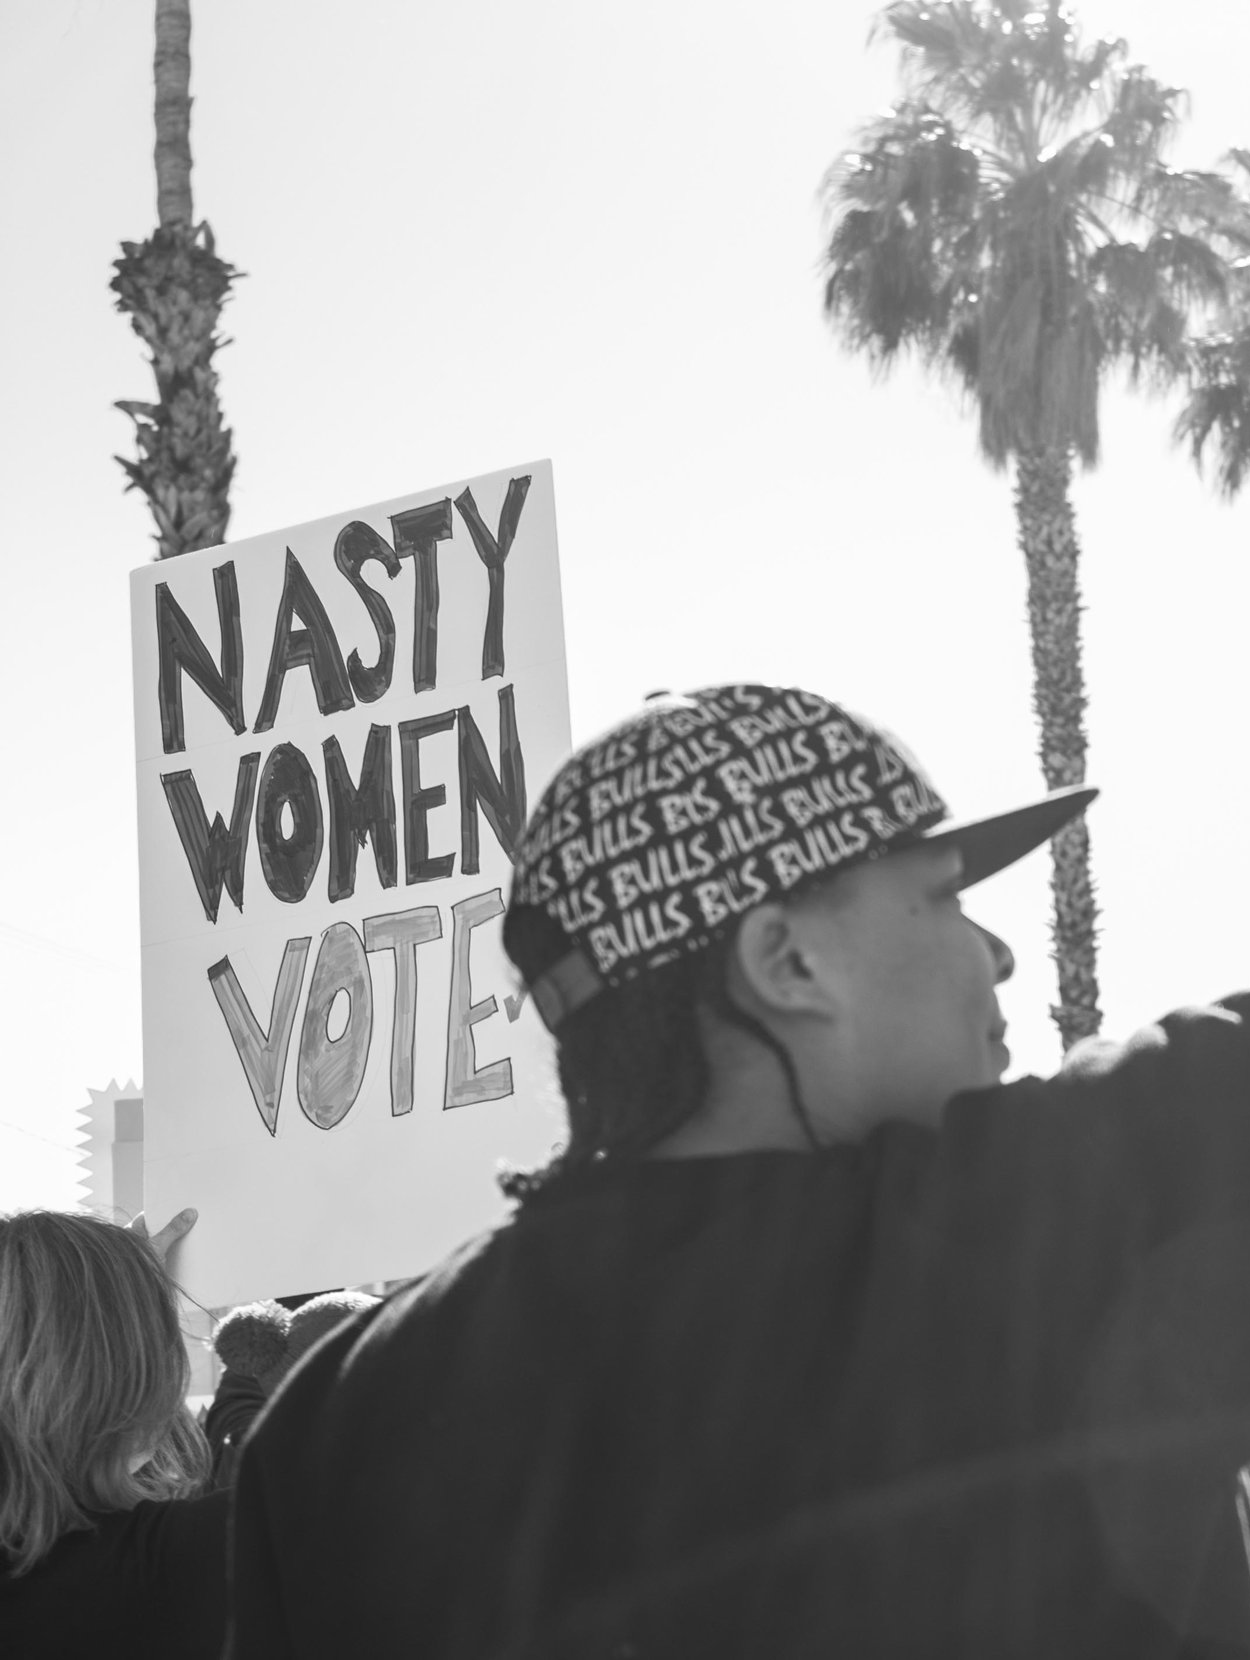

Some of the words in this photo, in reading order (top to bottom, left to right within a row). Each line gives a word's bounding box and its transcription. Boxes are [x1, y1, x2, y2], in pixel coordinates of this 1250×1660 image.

[155, 475, 532, 754] NASTY
[160, 683, 527, 925] WOMEN
[558, 800, 654, 885] BULLS
[714, 729, 820, 804] BULLS
[587, 744, 685, 824] BULLS
[726, 694, 832, 749] BULLS
[606, 830, 716, 910] BULLS
[778, 761, 875, 828] BULLS
[587, 890, 694, 973] BULLS
[765, 810, 871, 890] BULLS
[207, 887, 514, 1137] VOTE
